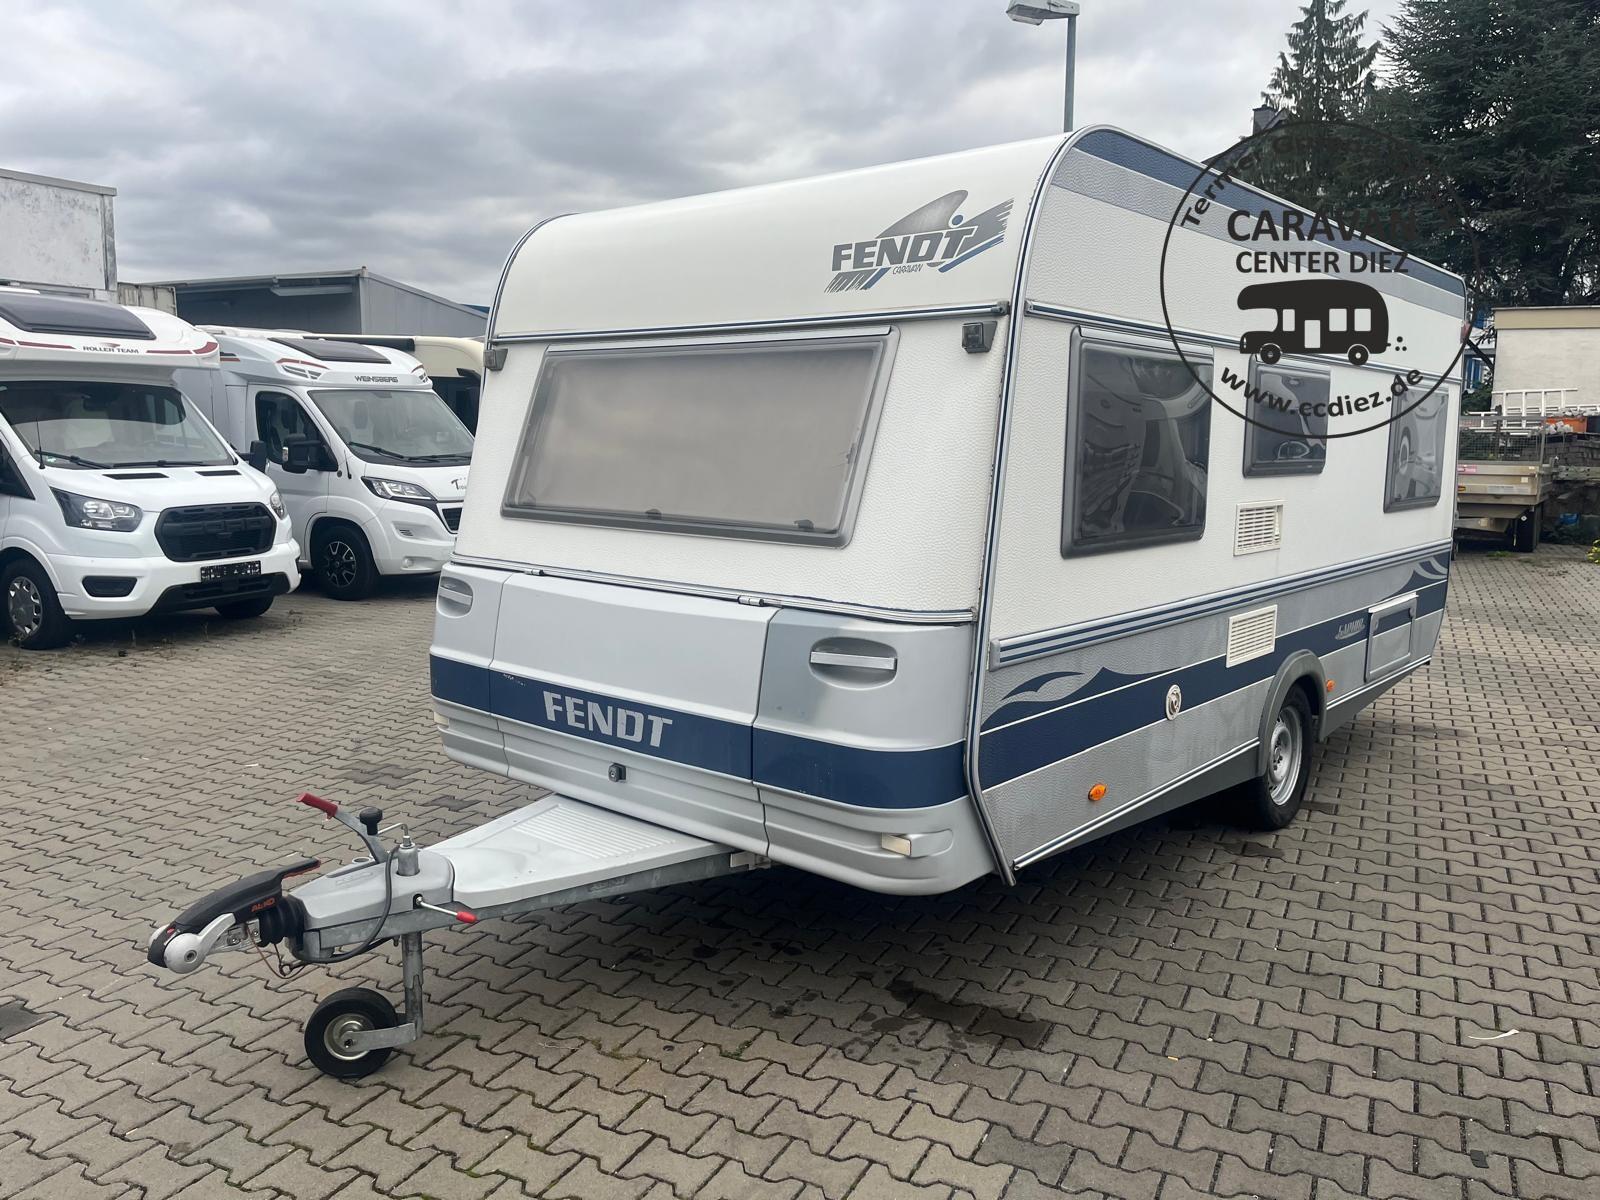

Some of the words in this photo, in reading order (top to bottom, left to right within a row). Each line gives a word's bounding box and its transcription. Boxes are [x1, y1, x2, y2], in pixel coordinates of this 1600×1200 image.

[832, 228, 975, 271] FENDT
[82, 345, 115, 353] ROLLER
[354, 375, 399, 383] WEINSBERG
[543, 690, 673, 748] FENDT
